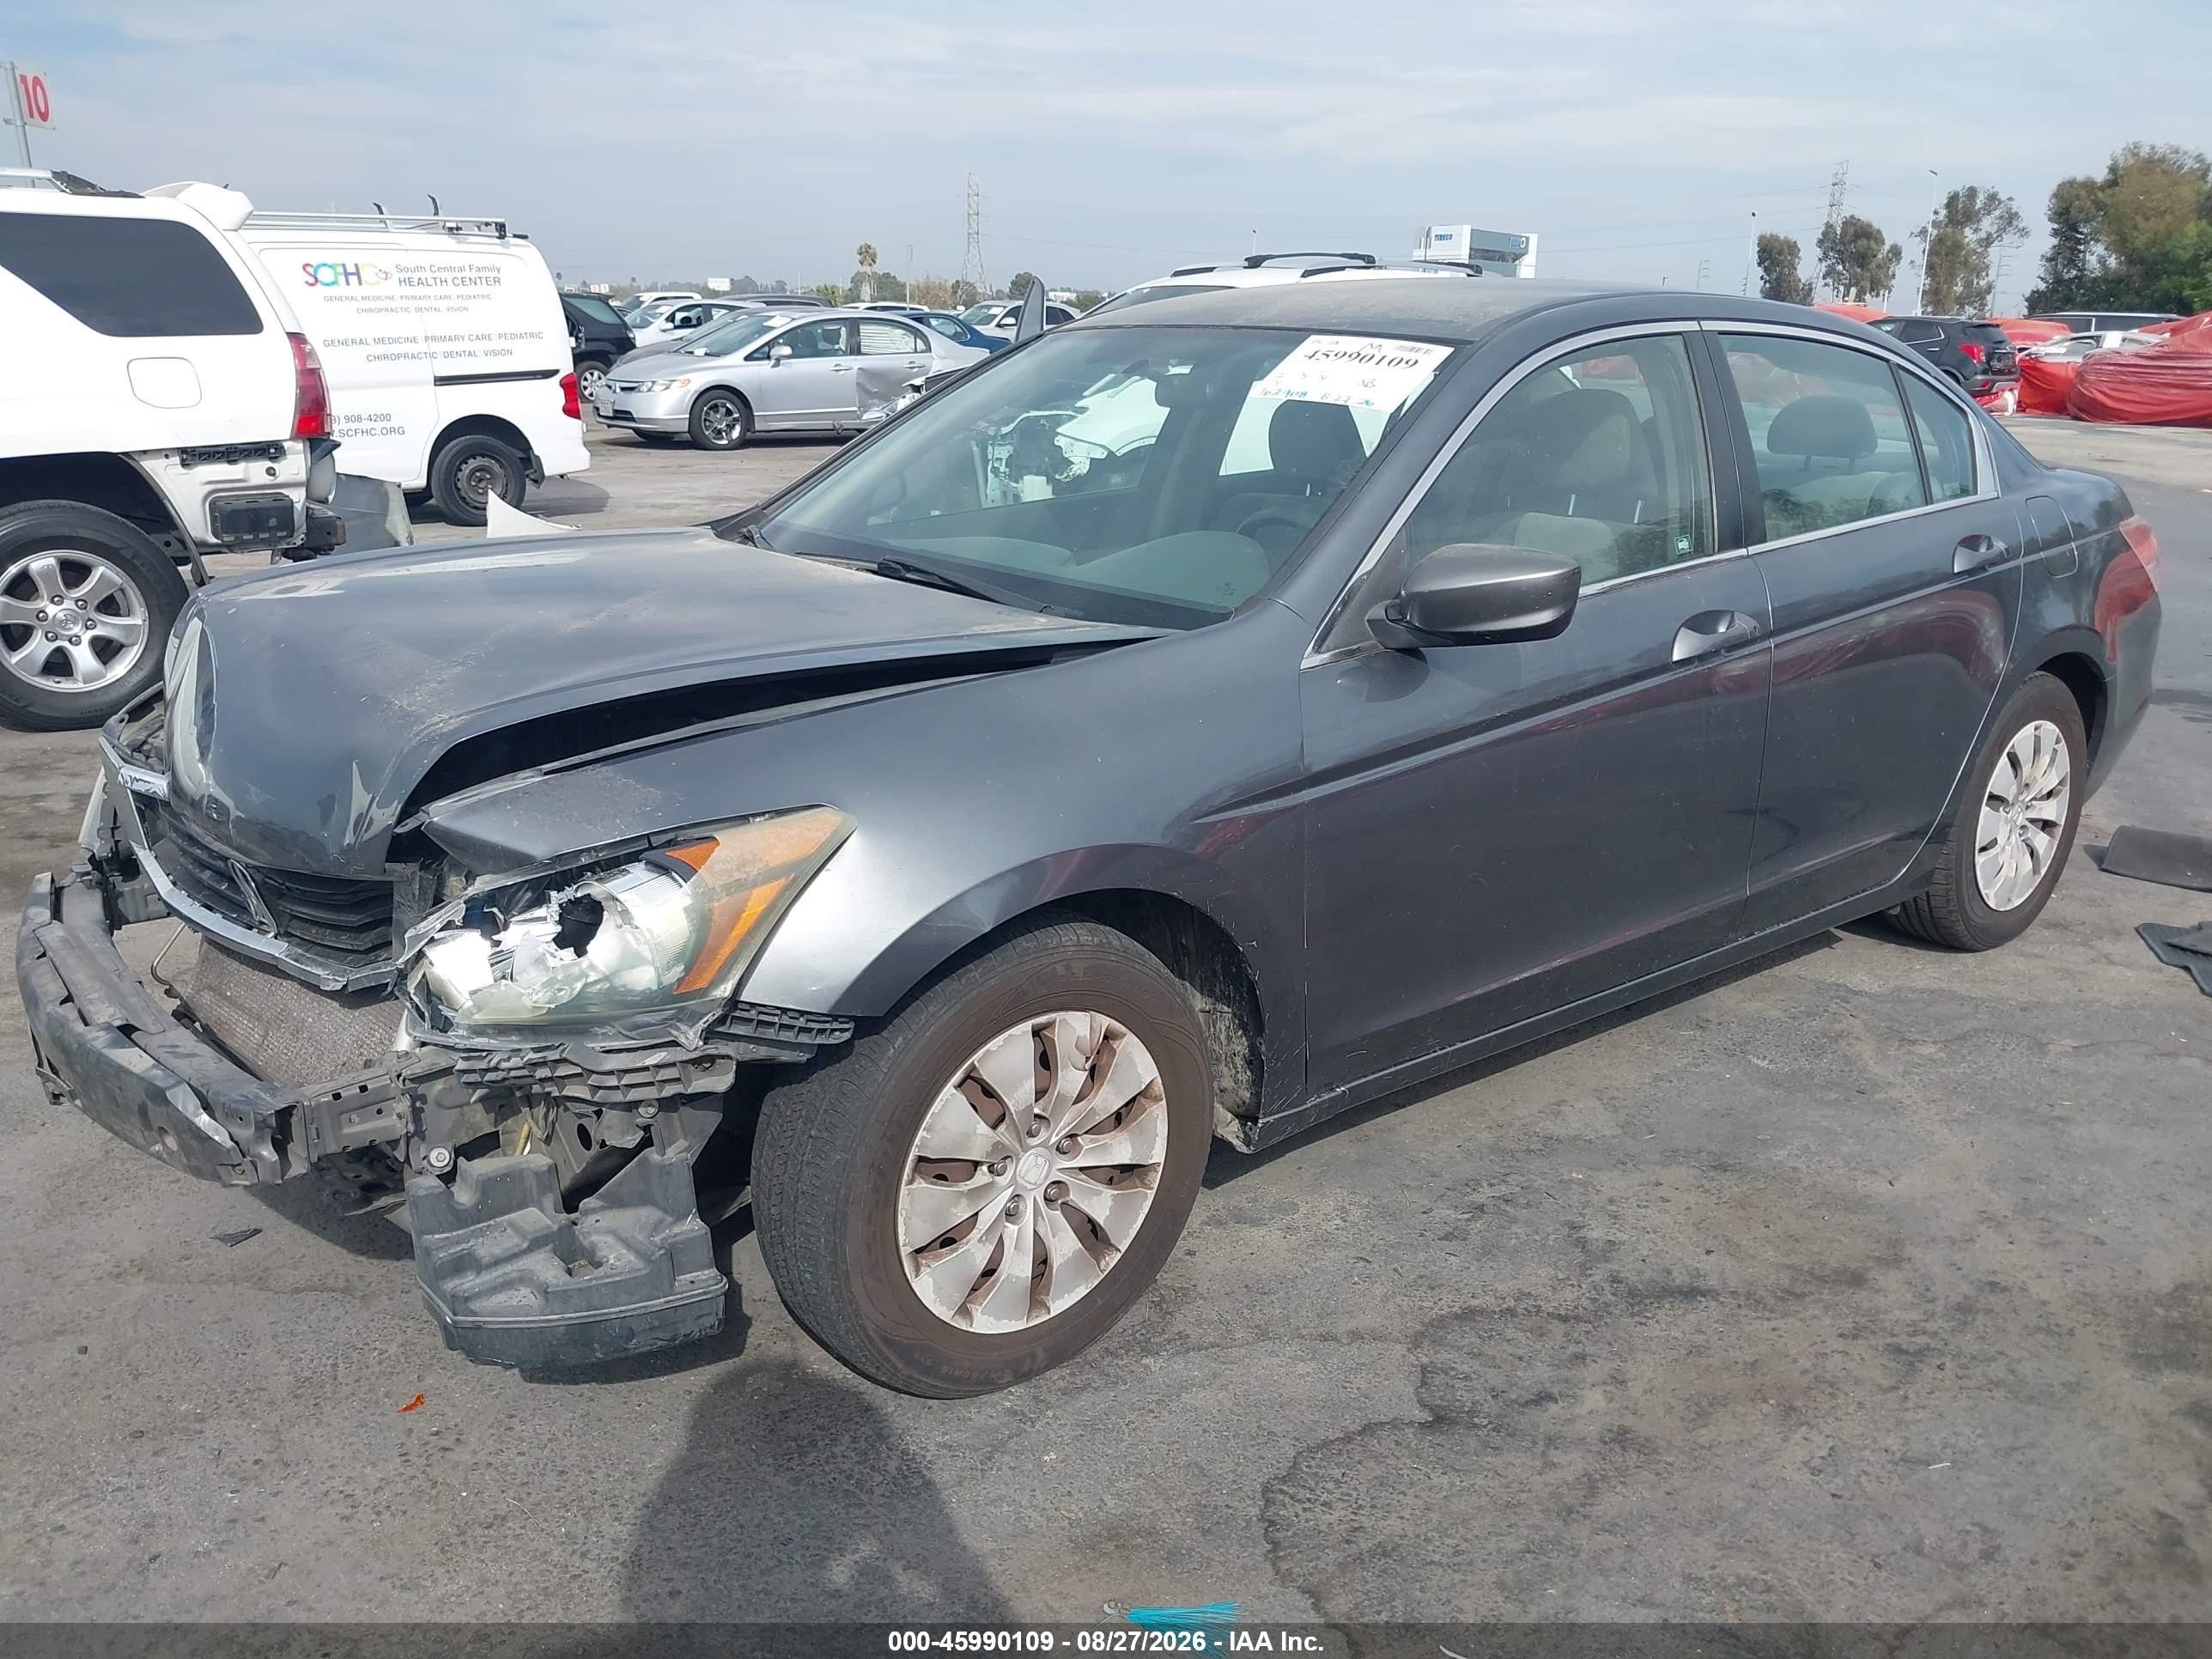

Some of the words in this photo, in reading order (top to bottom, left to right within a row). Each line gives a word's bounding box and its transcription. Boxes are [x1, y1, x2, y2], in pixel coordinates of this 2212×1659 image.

[19, 74, 50, 123] 10
[302, 263, 381, 287] SCFHC
[395, 264, 427, 273] South
[429, 264, 466, 273] Central
[469, 264, 501, 275] Family
[398, 276, 448, 287] HEALTH
[452, 276, 501, 287] CENTER
[323, 337, 371, 347] GENERAL
[374, 336, 419, 345] MEDICINE
[424, 334, 465, 343] PRIMARY
[468, 333, 494, 342] CARE
[498, 331, 544, 341] PEDIATRIC
[366, 351, 438, 362] CHIROPRACTIC
[443, 349, 479, 359] DENTAL
[483, 348, 514, 357] VISION
[1304, 349, 1419, 369] 45990109
[343, 413, 392, 424] 908-4200
